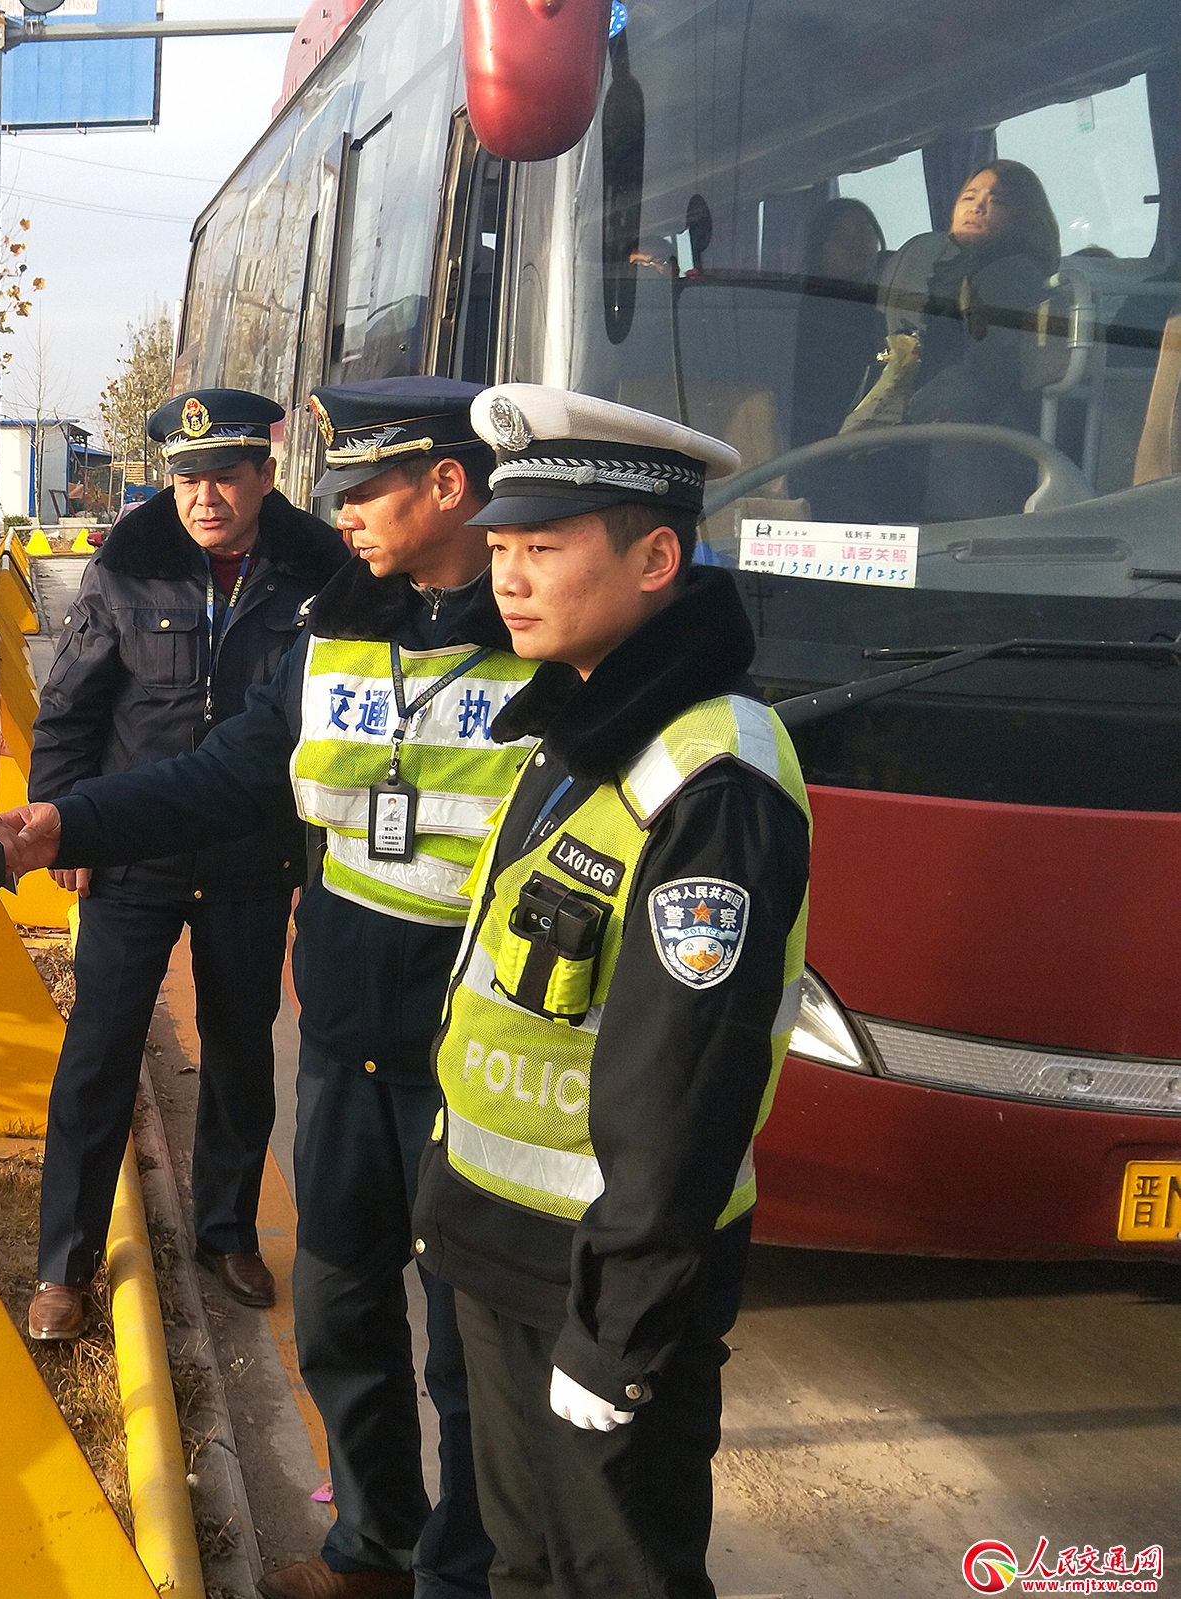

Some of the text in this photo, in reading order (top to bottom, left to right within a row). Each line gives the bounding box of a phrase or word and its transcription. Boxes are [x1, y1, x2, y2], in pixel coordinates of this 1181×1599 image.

[750, 542, 907, 563] 临时停靠 请多关照
[779, 561, 908, 581] 13513599255
[327, 683, 392, 736] 交通
[457, 689, 510, 741] 执
[555, 840, 616, 887] LX0166
[655, 885, 744, 910] 中华人民共和国
[683, 927, 722, 938] POLICE
[462, 1038, 587, 1114] POLIC
